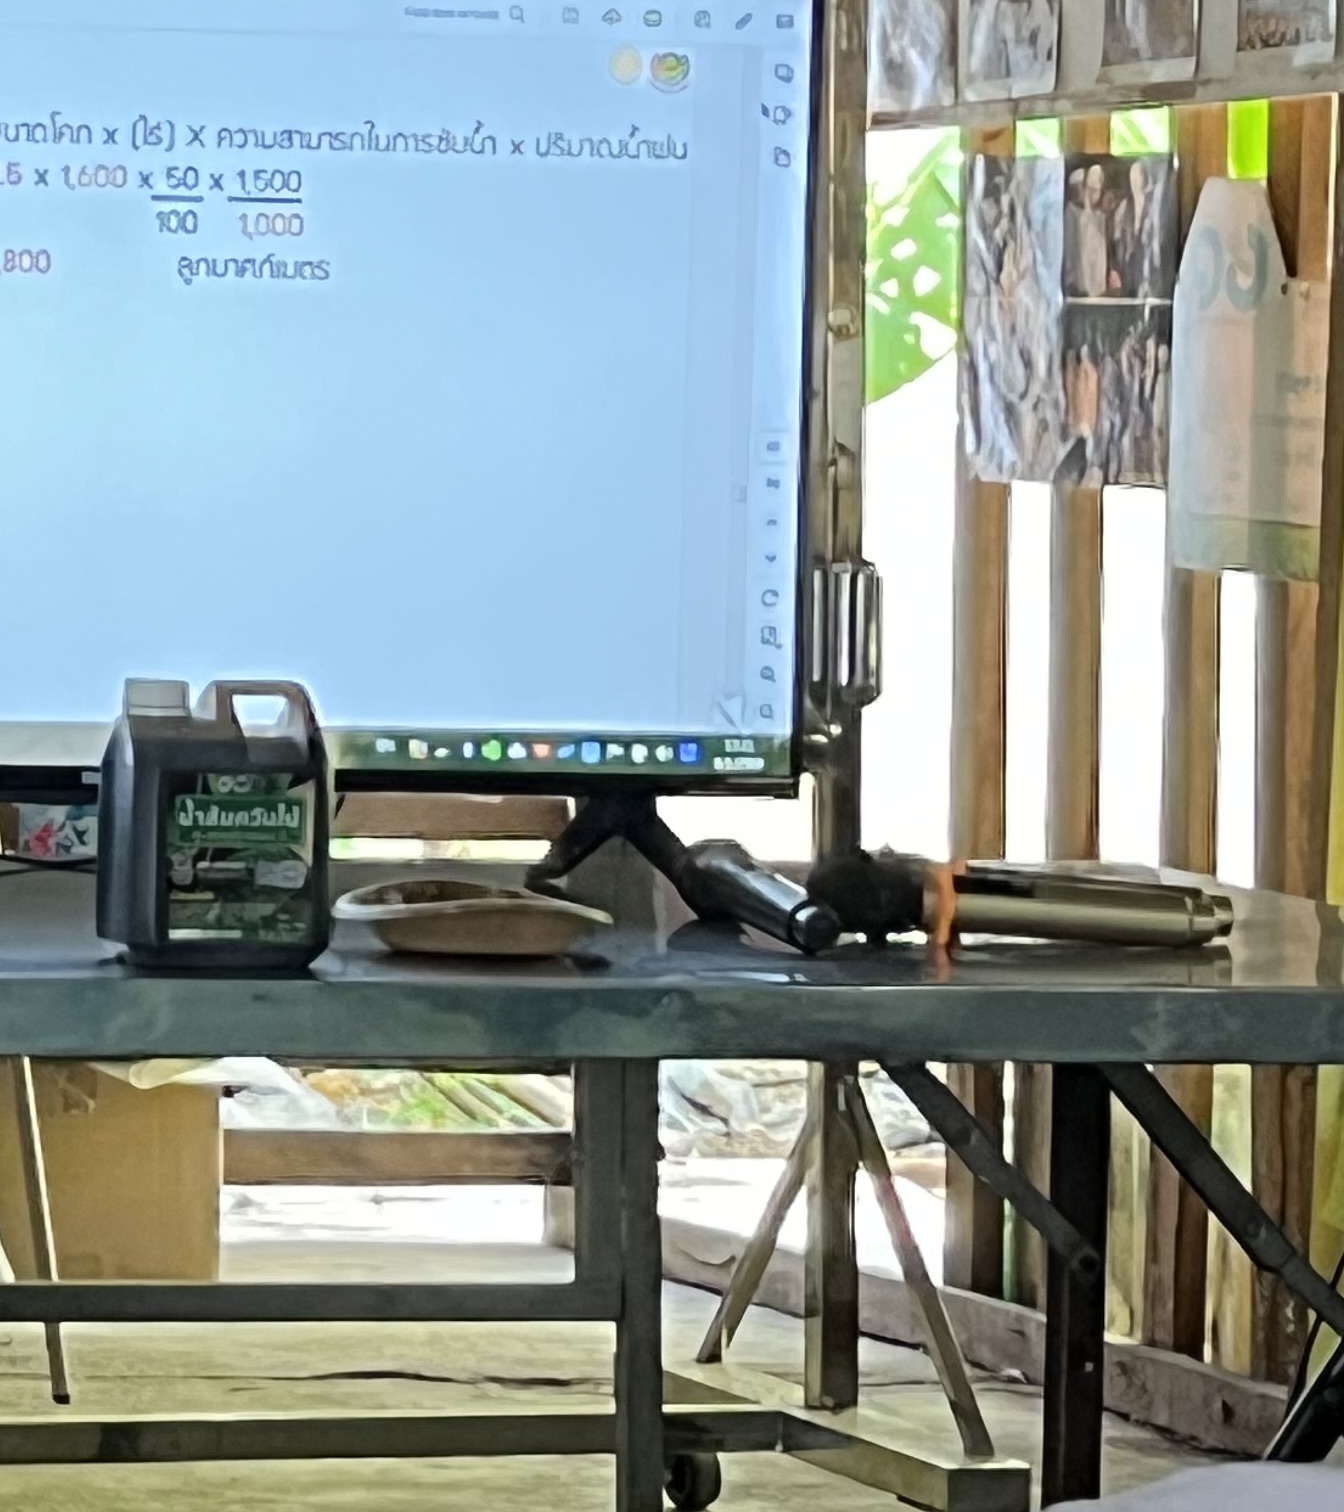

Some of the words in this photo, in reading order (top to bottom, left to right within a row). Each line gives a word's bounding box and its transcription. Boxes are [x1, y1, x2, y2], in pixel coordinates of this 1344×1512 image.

[536, 123, 687, 160] ปริมาณน้ำฝน
[61, 164, 127, 190] 1,600
[165, 166, 199, 190] 50
[236, 169, 302, 196] 1,500
[156, 208, 198, 234] 100
[238, 212, 304, 241] 1,000
